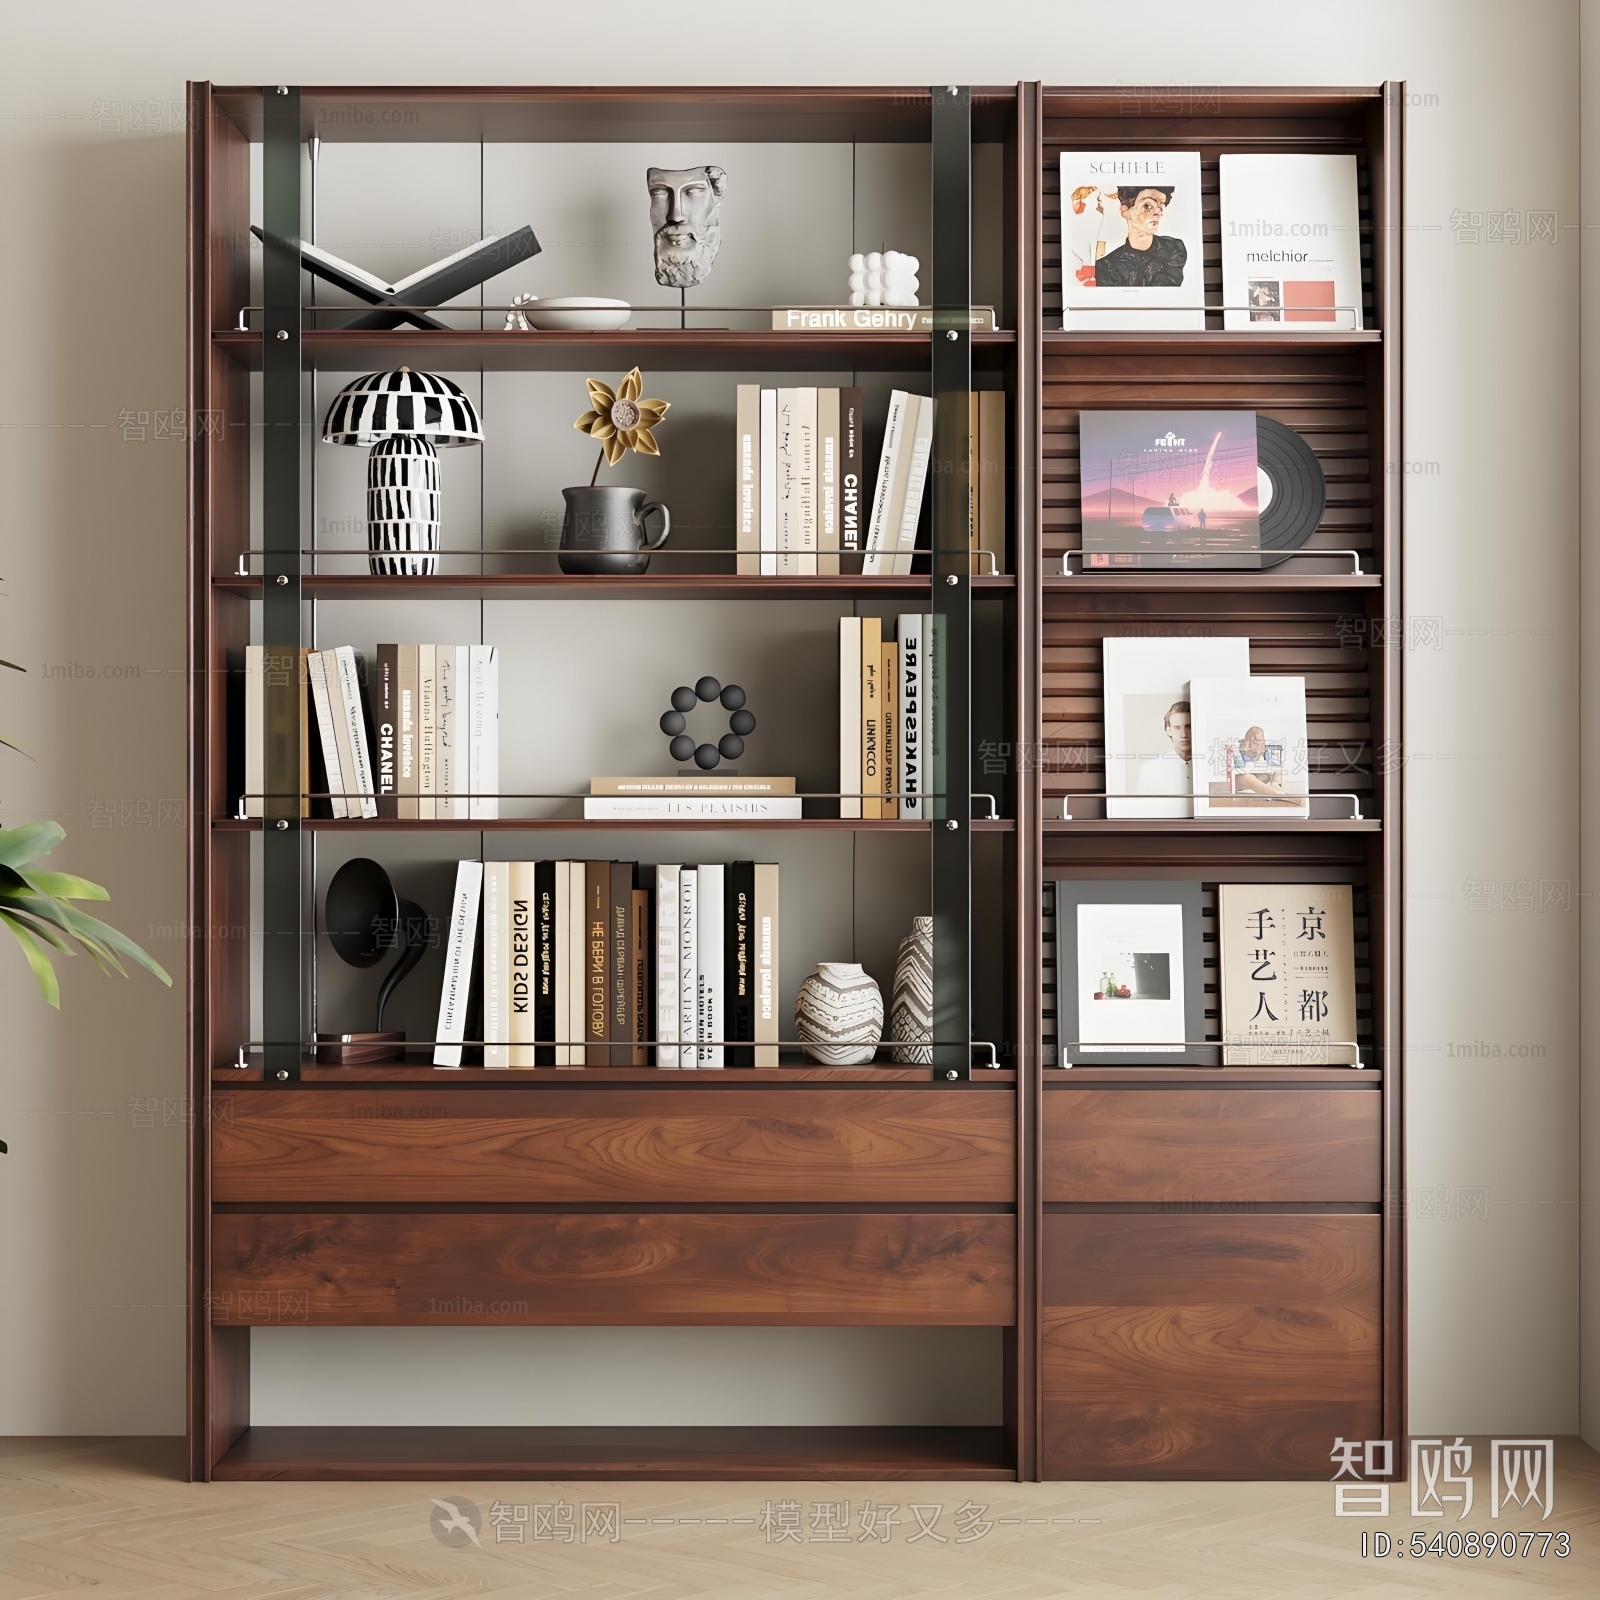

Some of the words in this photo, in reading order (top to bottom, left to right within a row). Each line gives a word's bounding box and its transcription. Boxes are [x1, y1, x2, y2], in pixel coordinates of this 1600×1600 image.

[1090, 161, 1166, 174] SCHIELE
[1246, 249, 1308, 262] melchior
[787, 310, 847, 328] Frank
[853, 310, 918, 331] Gehry
[381, 723, 393, 795] CHANEL
[592, 921, 604, 937] НЕ
[592, 940, 604, 973] БЕРИ
[1245, 908, 1279, 1022] 手艺人
[592, 987, 604, 1037] ГОЛОВУ
